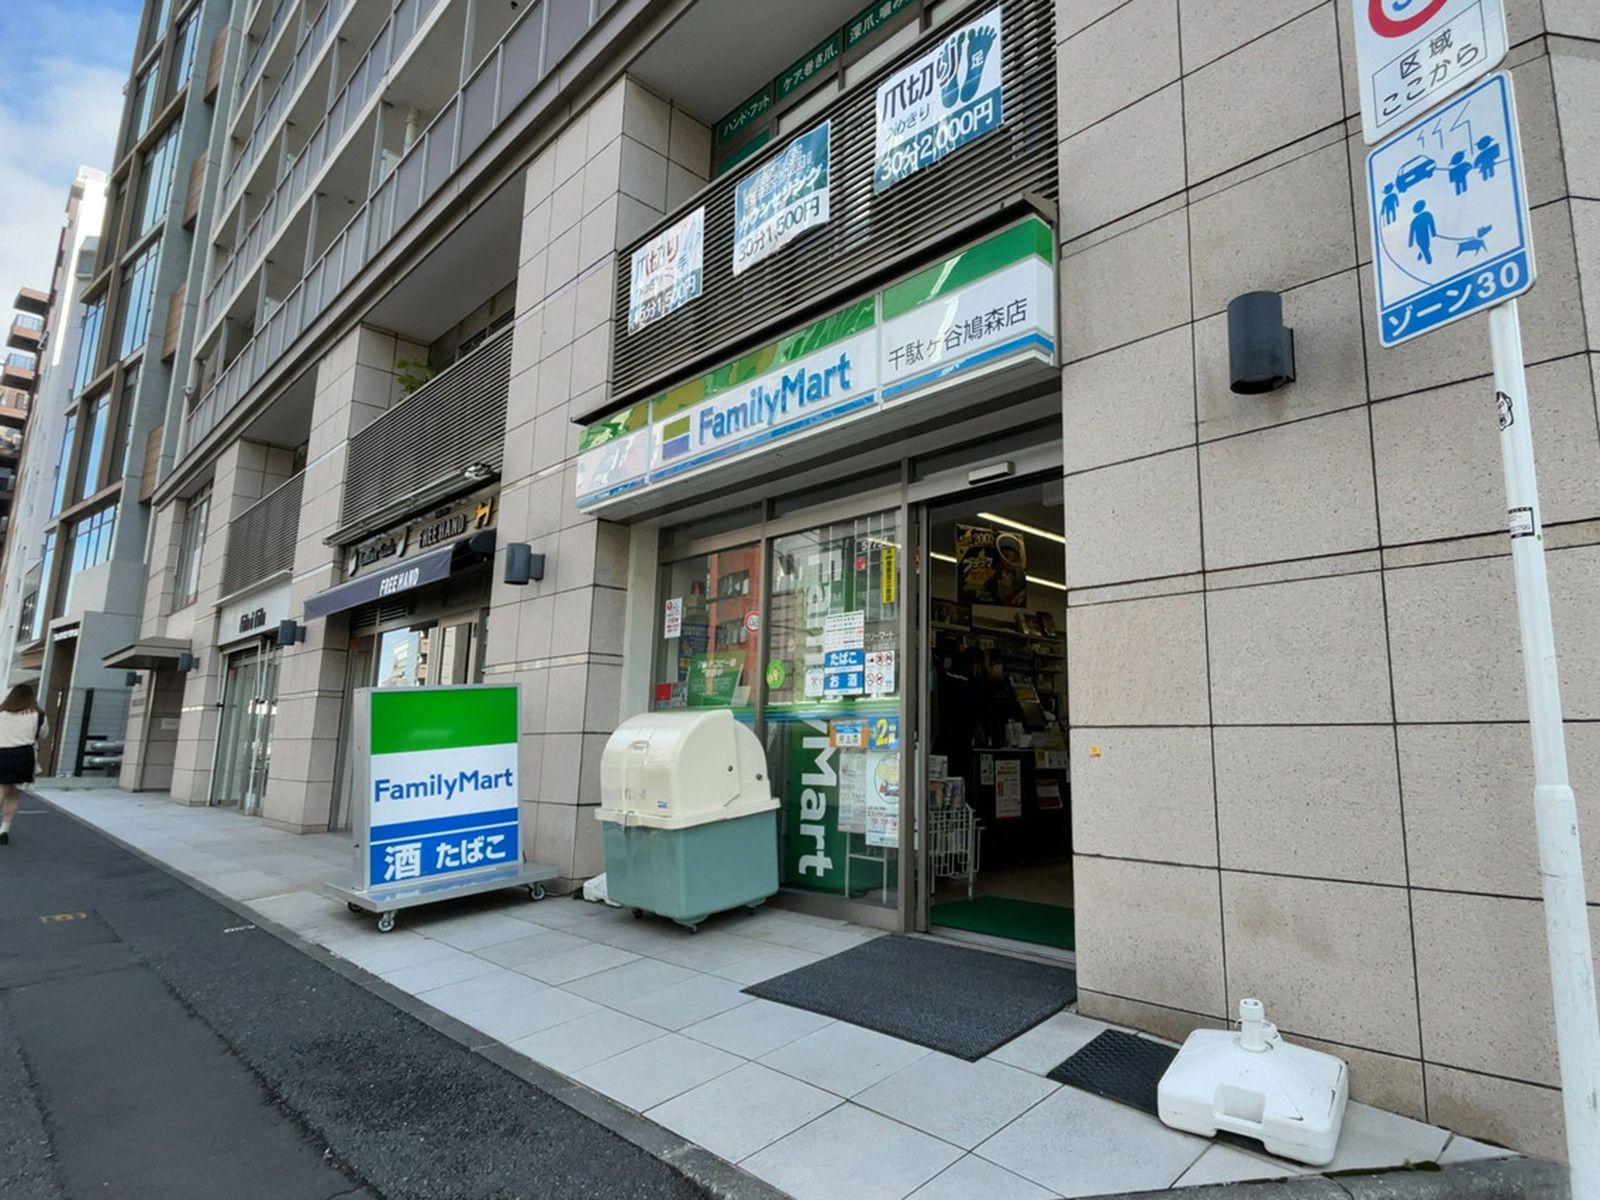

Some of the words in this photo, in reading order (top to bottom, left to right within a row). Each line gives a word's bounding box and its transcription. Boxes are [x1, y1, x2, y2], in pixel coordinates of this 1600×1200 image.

[883, 37, 959, 122] 爪切り
[971, 50, 984, 70] 足
[1383, 43, 1479, 116] ここから
[1400, 28, 1453, 79] 区域
[881, 97, 994, 181] 30分2,000円
[738, 196, 819, 262] 30分1,500円
[1389, 261, 1519, 336] ゾーン30
[889, 298, 1027, 371] 千駄ヶ谷鳩森店
[699, 352, 851, 445] FamilyMart
[379, 577, 397, 597] FREE
[398, 568, 419, 590] HAND
[830, 652, 858, 666] たばこ
[375, 768, 513, 801] FamilyMart
[384, 842, 421, 881] 酒
[436, 834, 506, 869] たばこ
